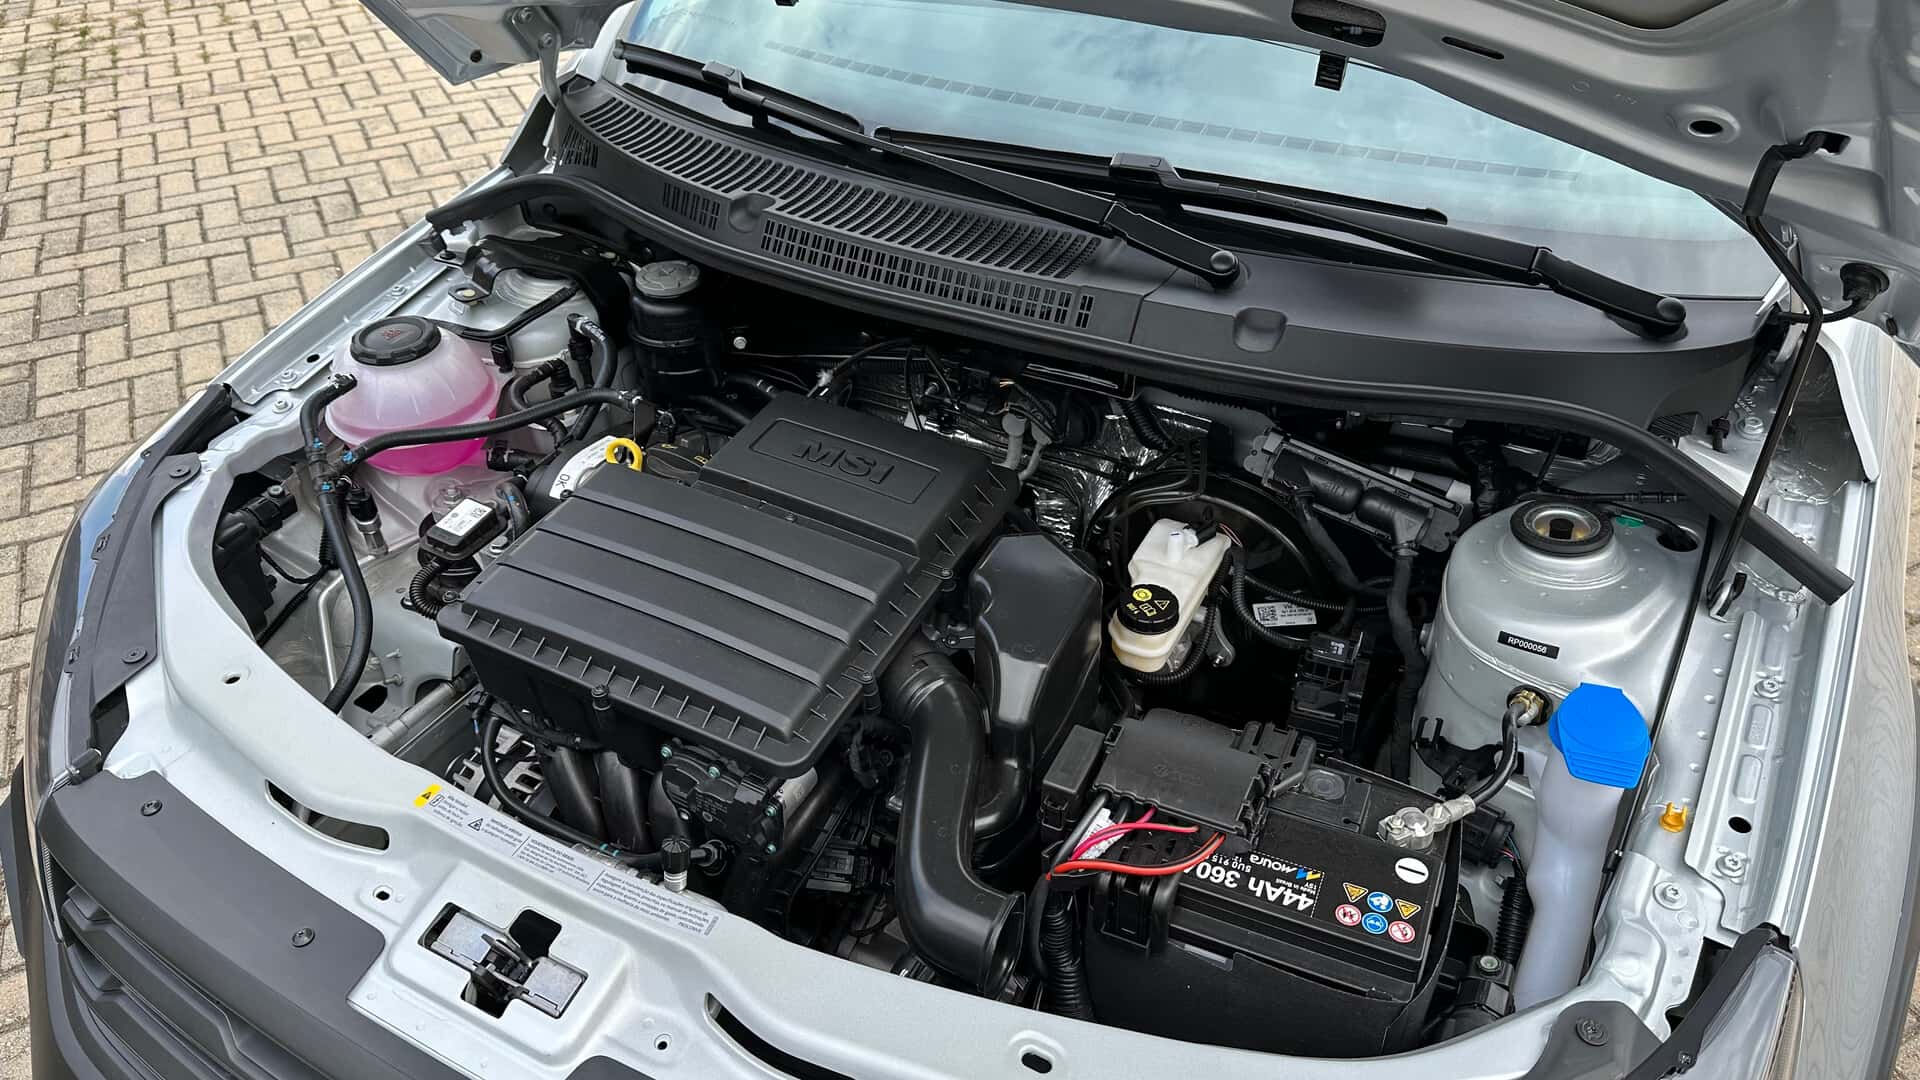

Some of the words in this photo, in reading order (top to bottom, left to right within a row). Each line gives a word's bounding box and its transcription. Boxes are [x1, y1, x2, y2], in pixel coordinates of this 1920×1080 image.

[792, 440, 895, 485] MSI
[1183, 861, 1241, 889] 360
[1248, 877, 1315, 911] 44Ah
